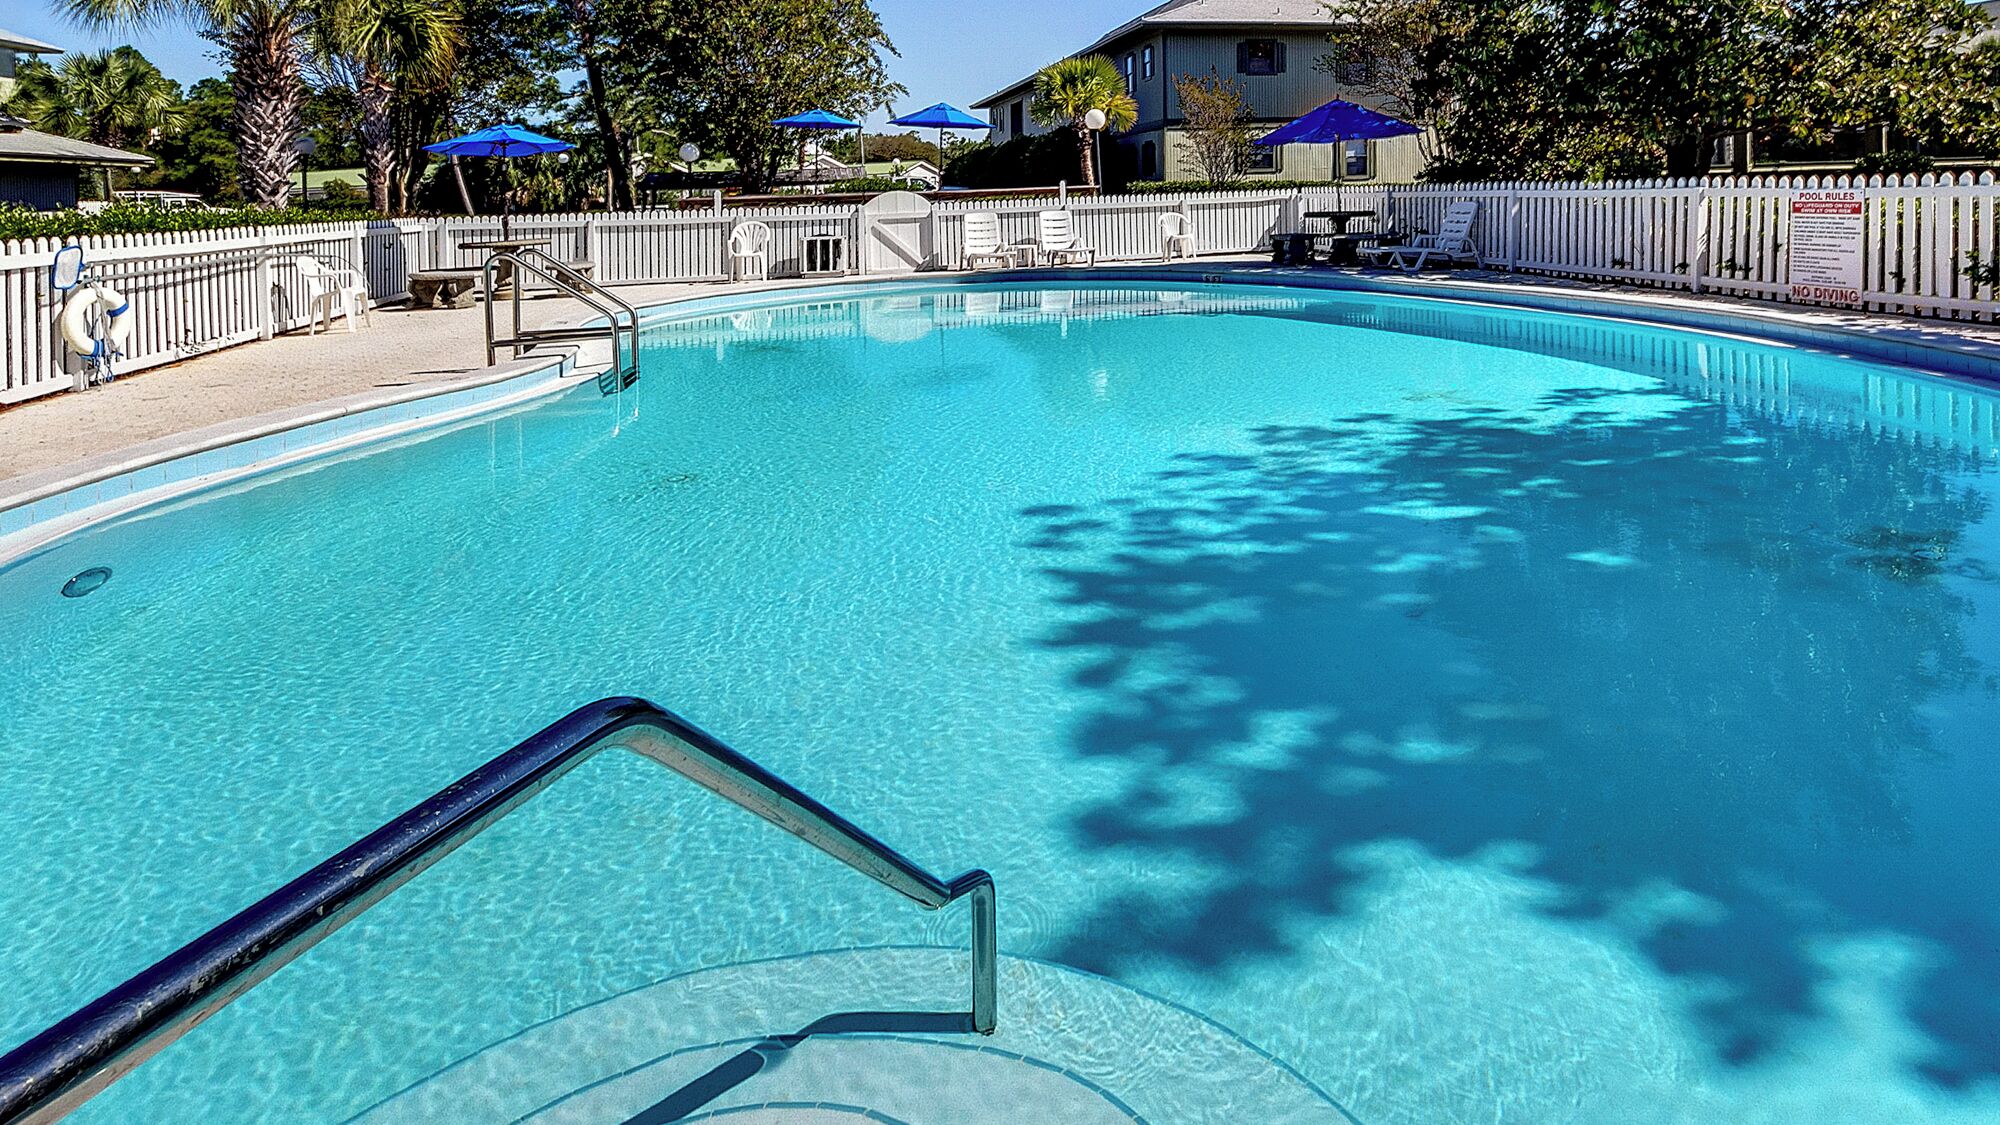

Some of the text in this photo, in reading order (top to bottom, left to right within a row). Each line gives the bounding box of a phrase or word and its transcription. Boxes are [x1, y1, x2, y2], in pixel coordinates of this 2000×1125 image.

[1799, 192, 1855, 200] POOL RULES
[1792, 285, 1860, 302] NO DIVING
